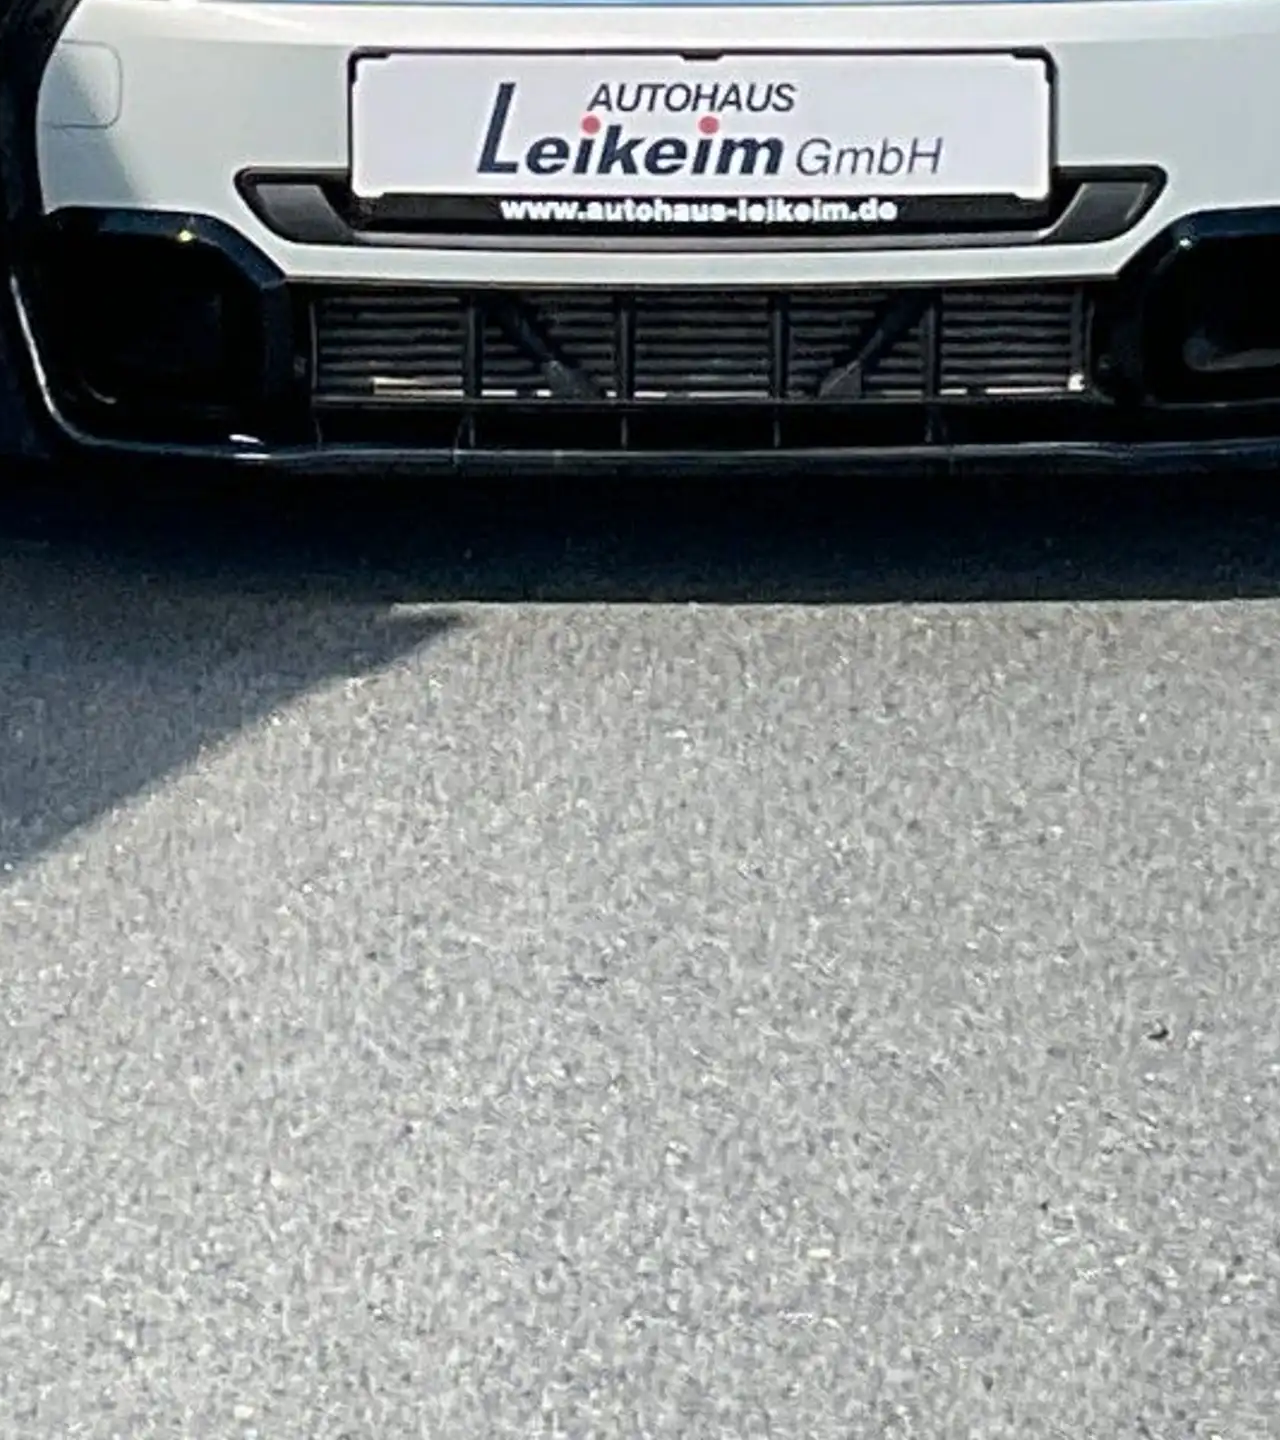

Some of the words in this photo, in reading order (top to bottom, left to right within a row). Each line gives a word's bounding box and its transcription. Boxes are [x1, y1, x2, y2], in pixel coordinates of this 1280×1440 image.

[586, 82, 798, 113] AUTOHAUS
[476, 81, 785, 177] Leikeim
[795, 137, 944, 177] GmbH
[499, 197, 899, 223] www.autohaus-leikeim.de
